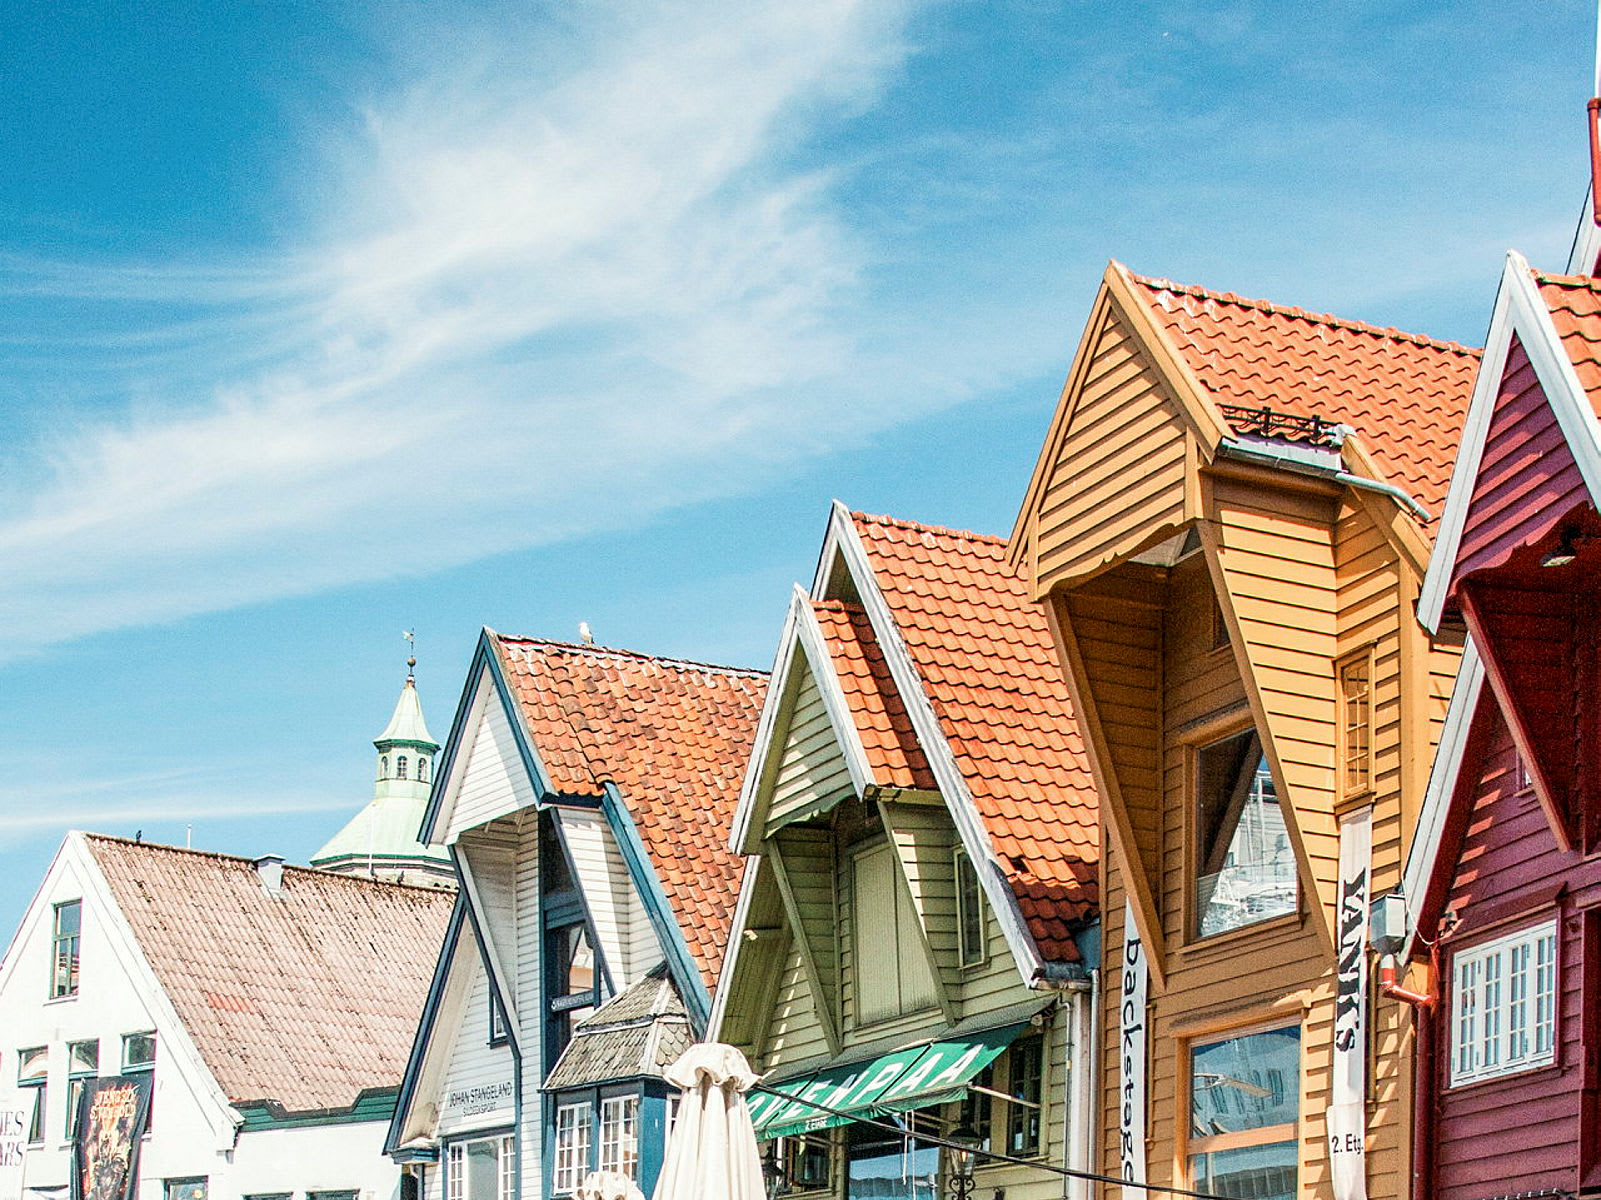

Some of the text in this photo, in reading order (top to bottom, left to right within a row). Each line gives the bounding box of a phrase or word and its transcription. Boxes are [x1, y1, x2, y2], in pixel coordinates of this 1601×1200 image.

[1120, 937, 1142, 1186] backstage
[470, 1082, 513, 1104] STANGELAND
[1331, 1135, 1343, 1153] 2.
